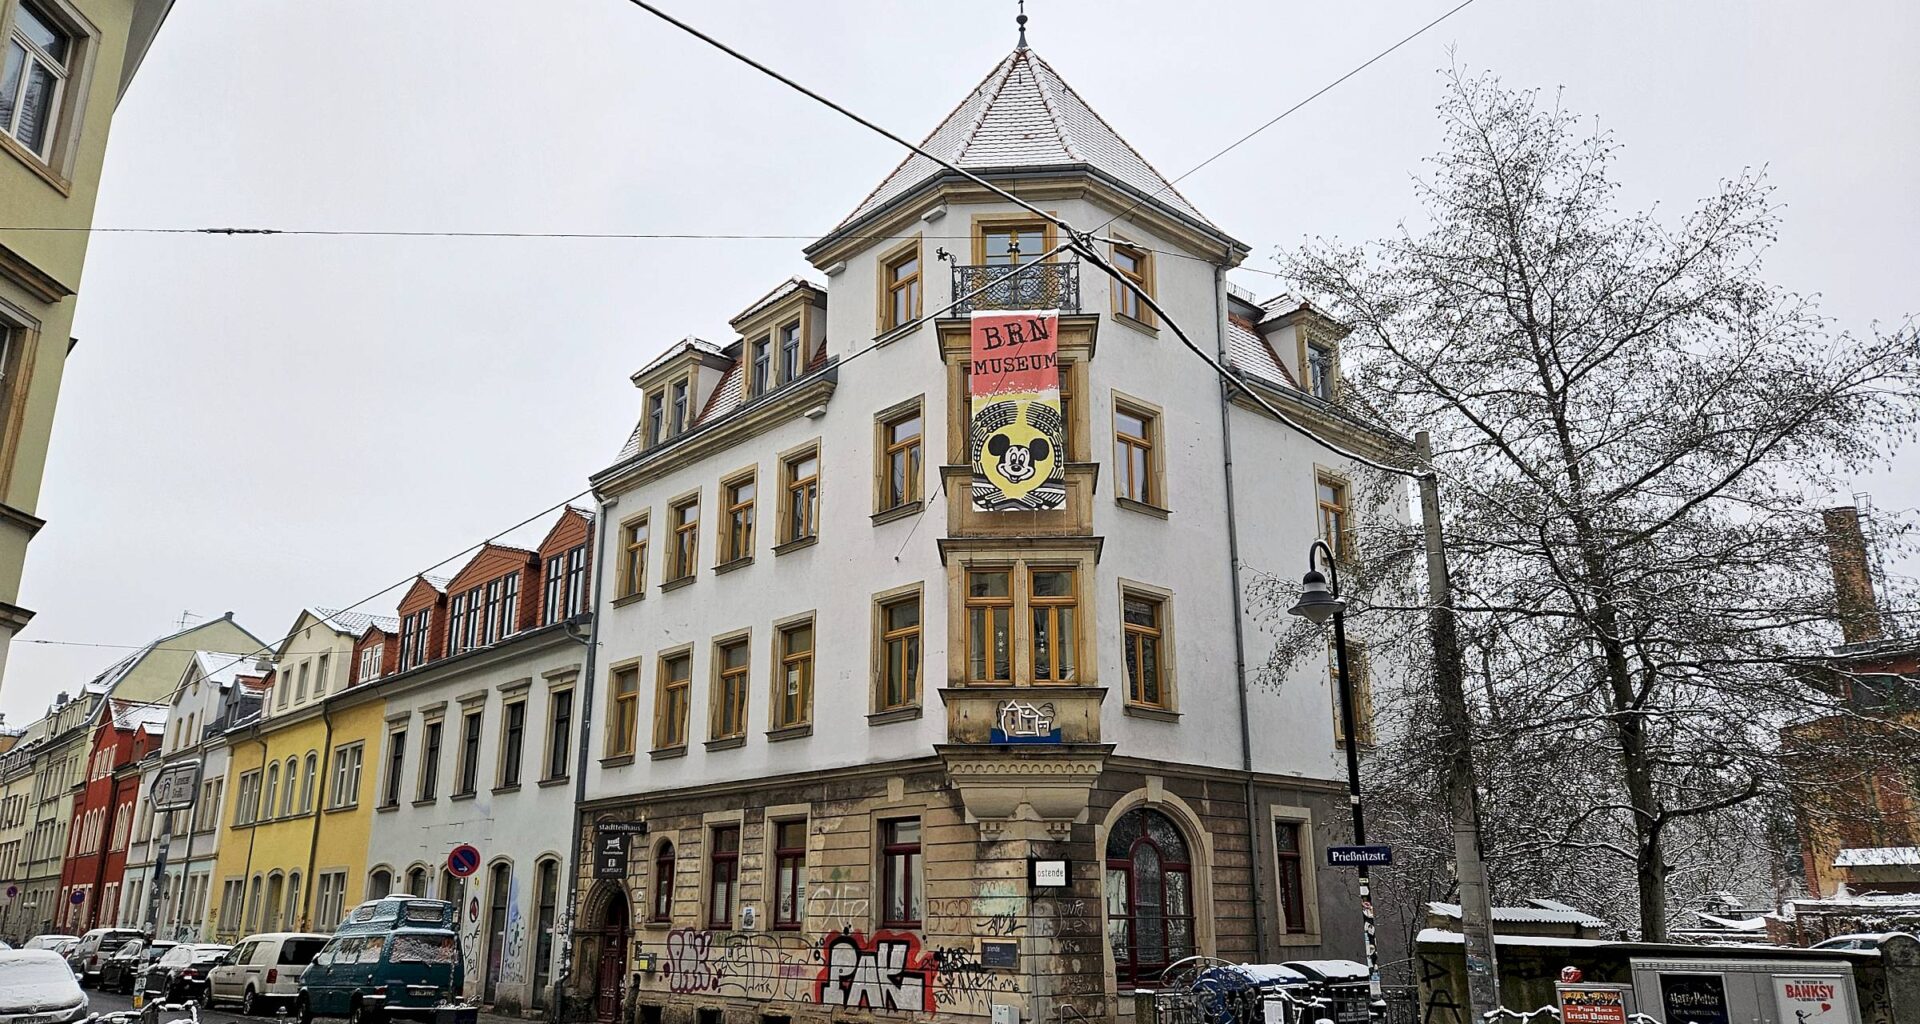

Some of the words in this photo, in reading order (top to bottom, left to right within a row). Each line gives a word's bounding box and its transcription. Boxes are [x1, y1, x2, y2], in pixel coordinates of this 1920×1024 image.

[980, 316, 1050, 350] BRN
[974, 352, 1058, 376] MUSEUM
[1332, 850, 1388, 862] Prießnitzstr.
[1037, 868, 1064, 878] ostende
[1670, 992, 1694, 1006] Harry
[1694, 991, 1719, 1005] Potter
[1785, 985, 1834, 999] BANKSY
[1567, 1011, 1589, 1020] Irish
[1590, 1012, 1620, 1021] Dance
